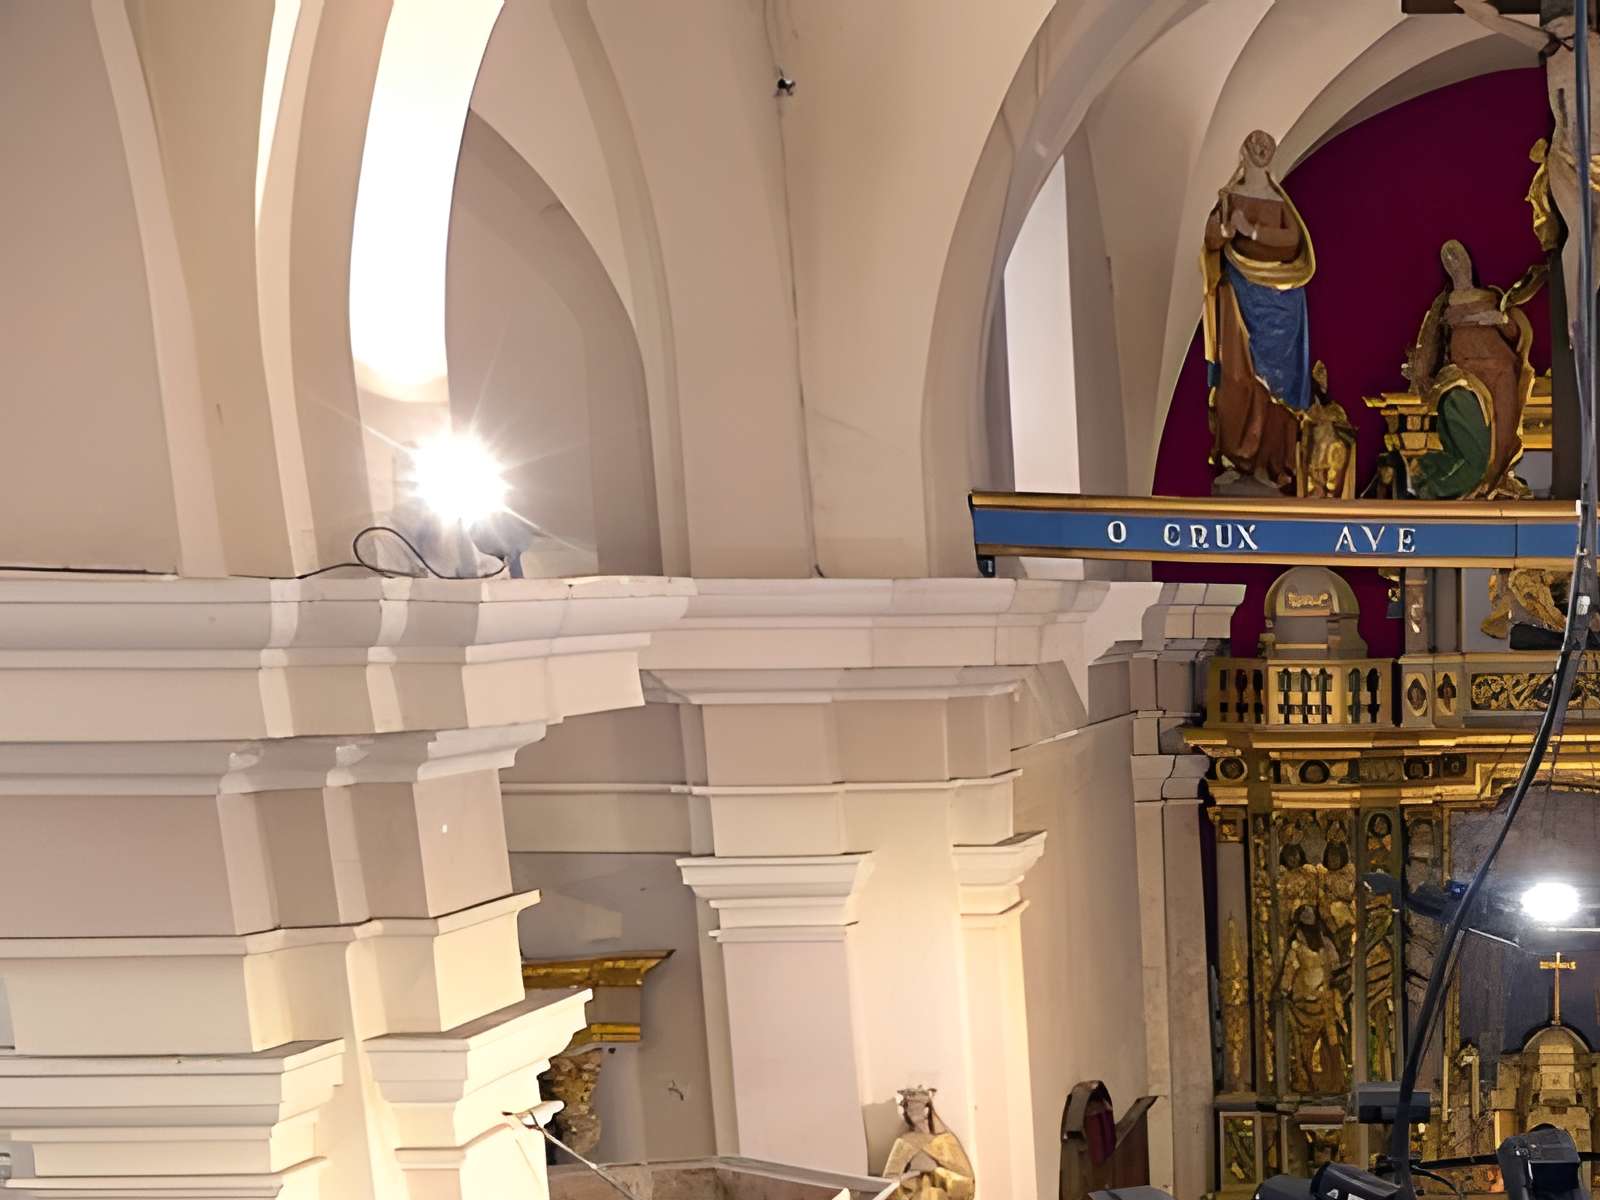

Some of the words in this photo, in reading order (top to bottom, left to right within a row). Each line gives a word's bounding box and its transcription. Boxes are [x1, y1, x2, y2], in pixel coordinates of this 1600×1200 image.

[1107, 520, 1127, 543] O
[1162, 523, 1259, 550] CRUX
[1335, 526, 1416, 552] AVE
